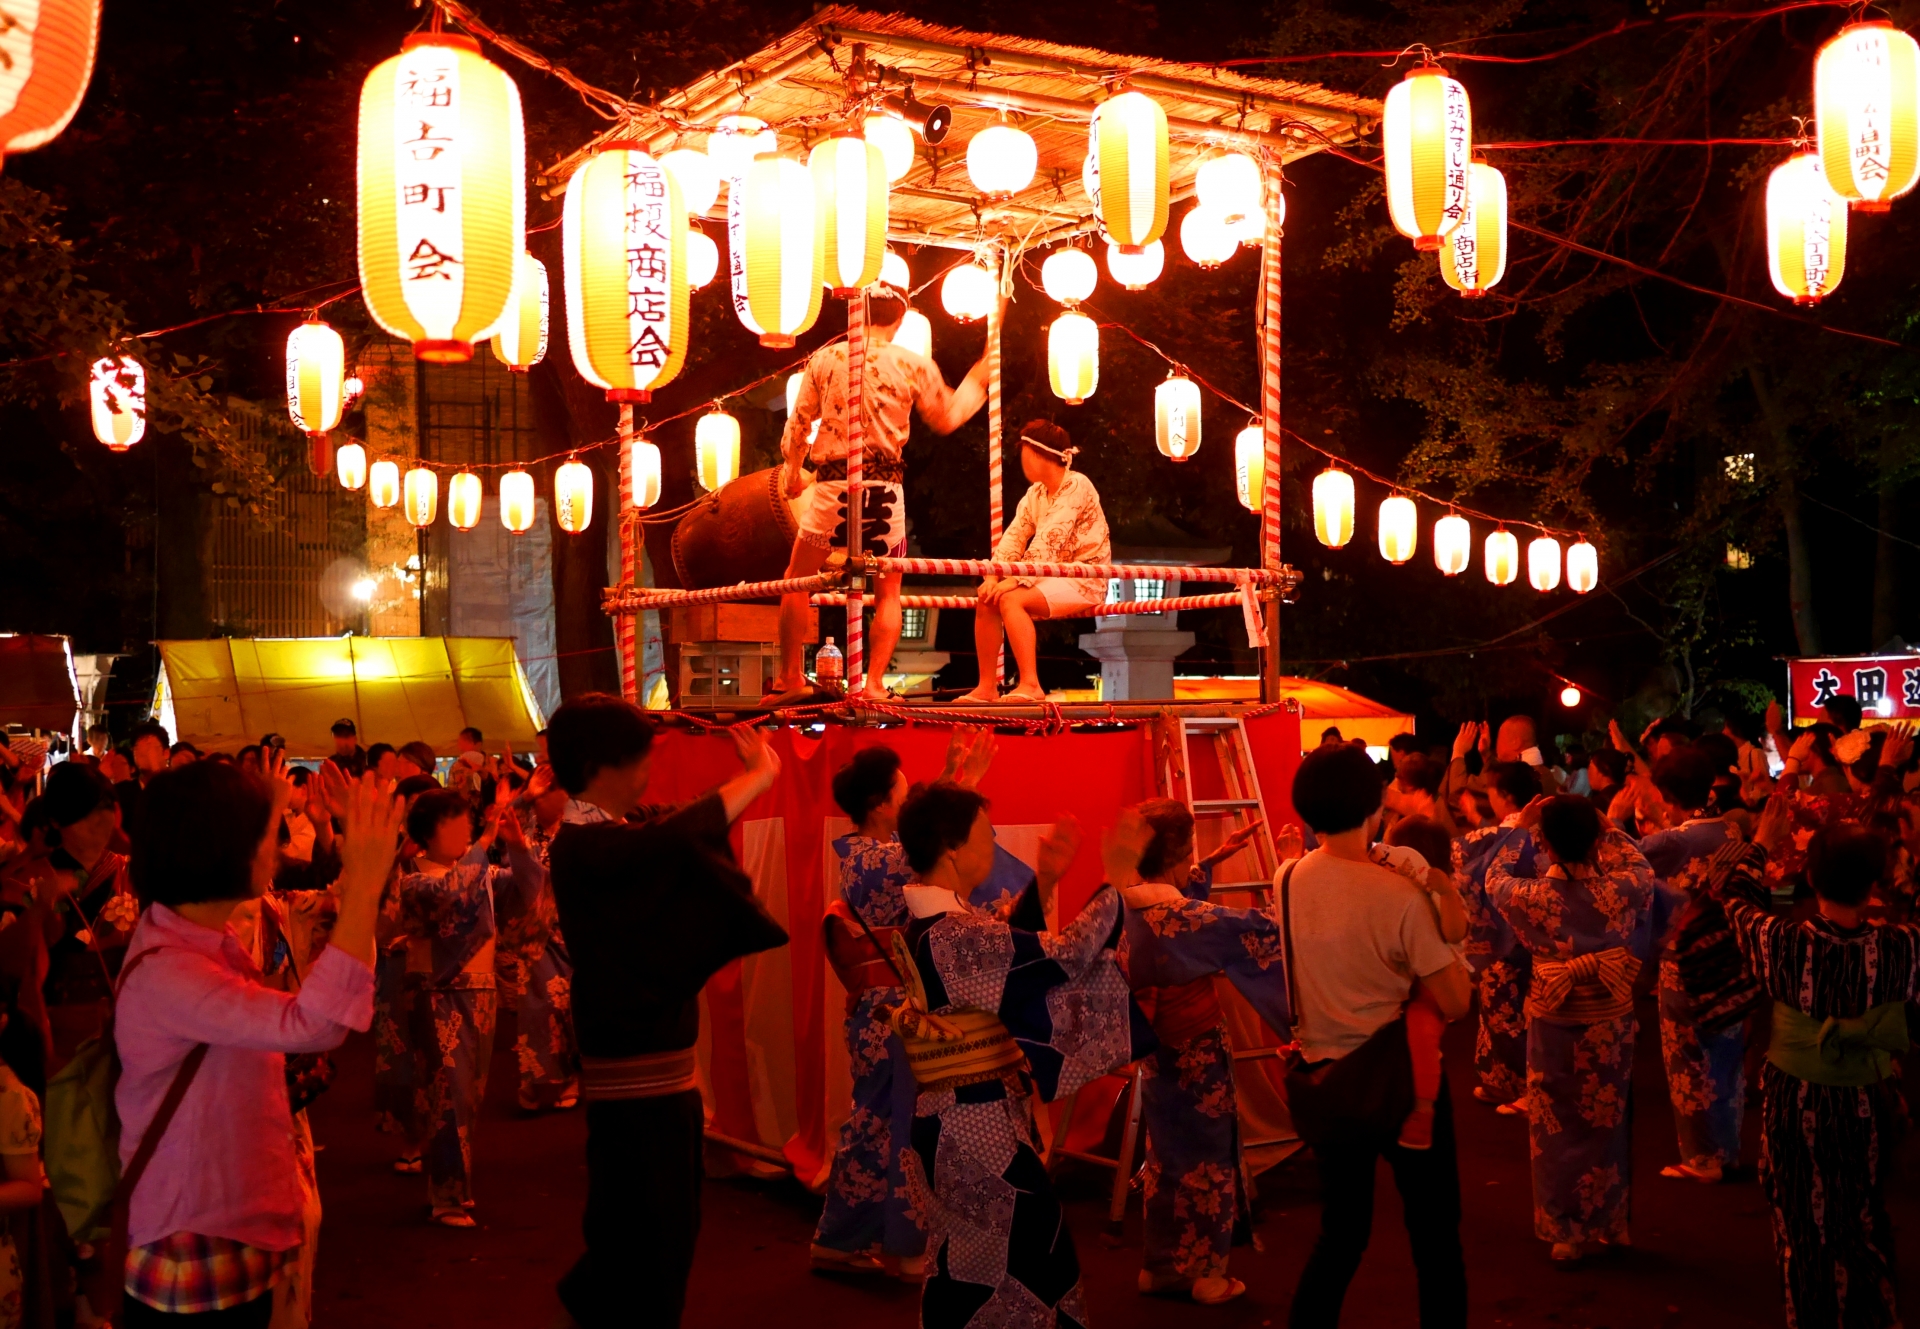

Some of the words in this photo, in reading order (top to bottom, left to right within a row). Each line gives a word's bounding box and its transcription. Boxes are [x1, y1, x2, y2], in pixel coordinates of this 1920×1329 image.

[1444, 84, 1466, 220] 赤坂みすじ通り会
